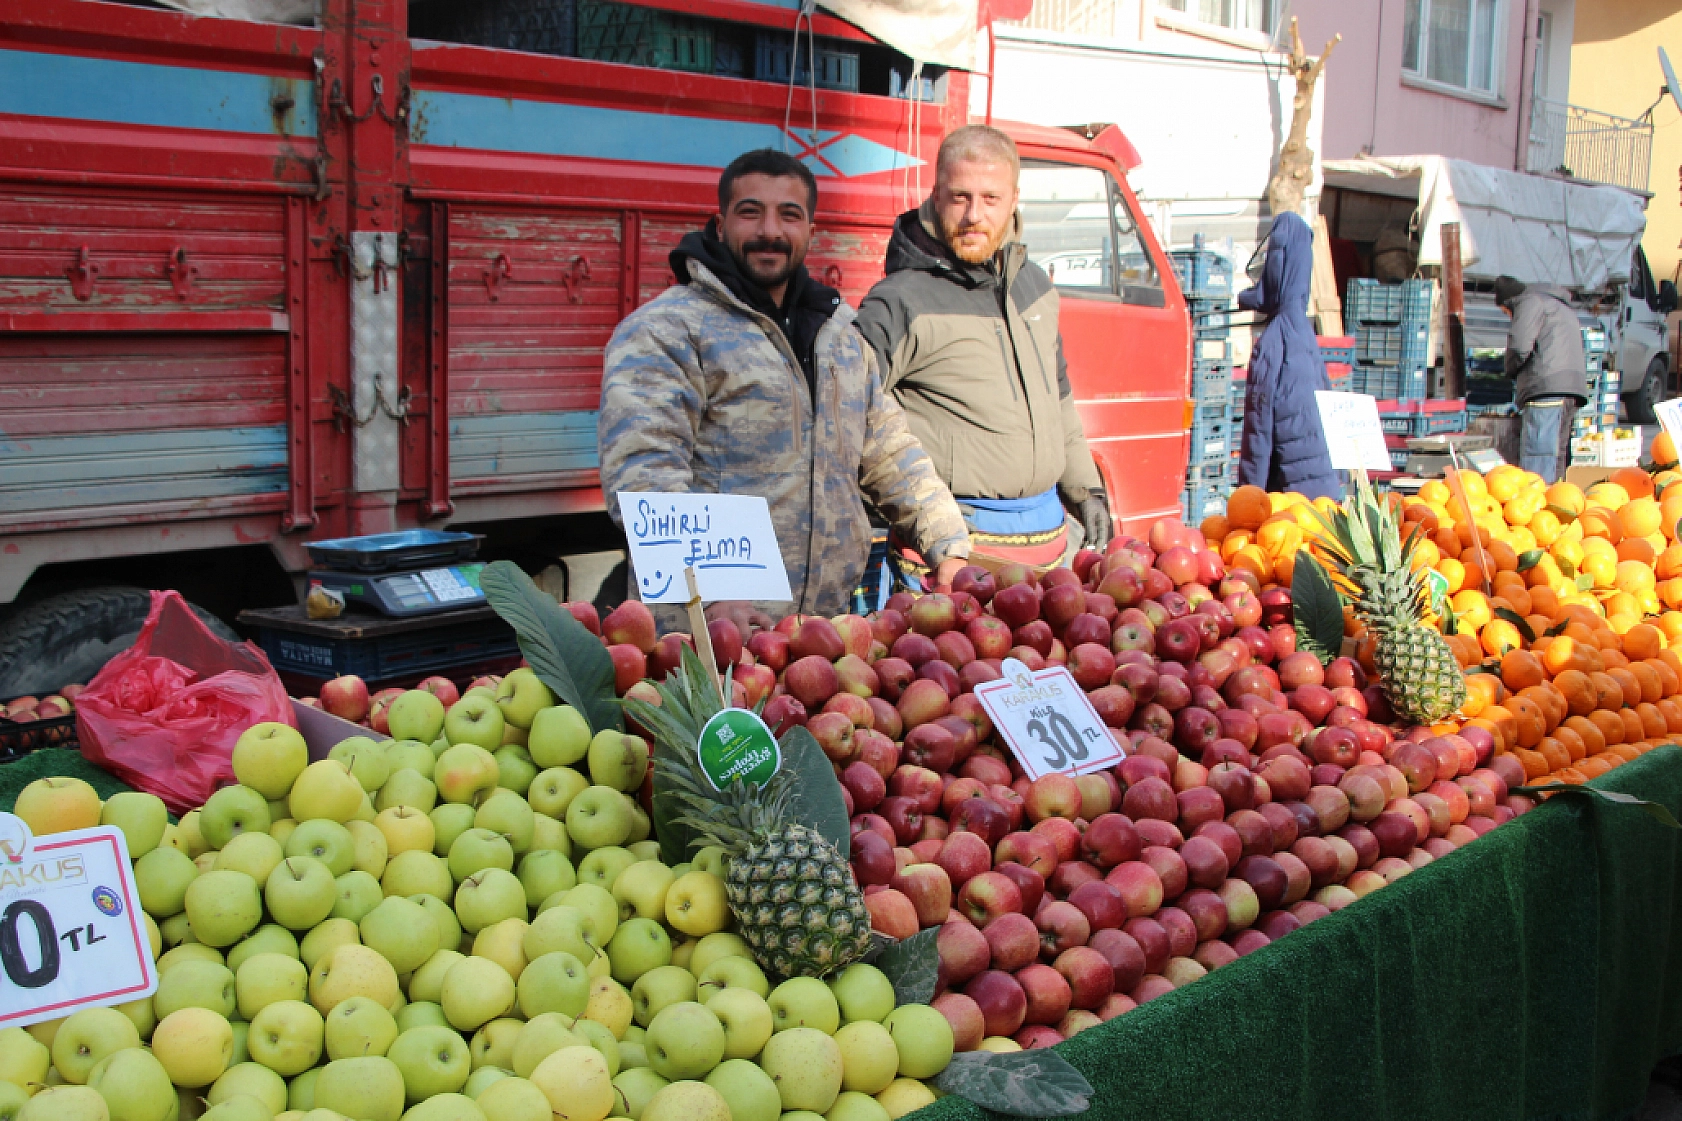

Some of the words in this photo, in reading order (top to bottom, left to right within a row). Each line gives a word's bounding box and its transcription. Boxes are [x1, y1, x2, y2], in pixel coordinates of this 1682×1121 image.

[683, 536, 752, 566] ELMA
[1027, 710, 1090, 770] 30
[1082, 727, 1101, 743] TL
[60, 923, 107, 952] TL
